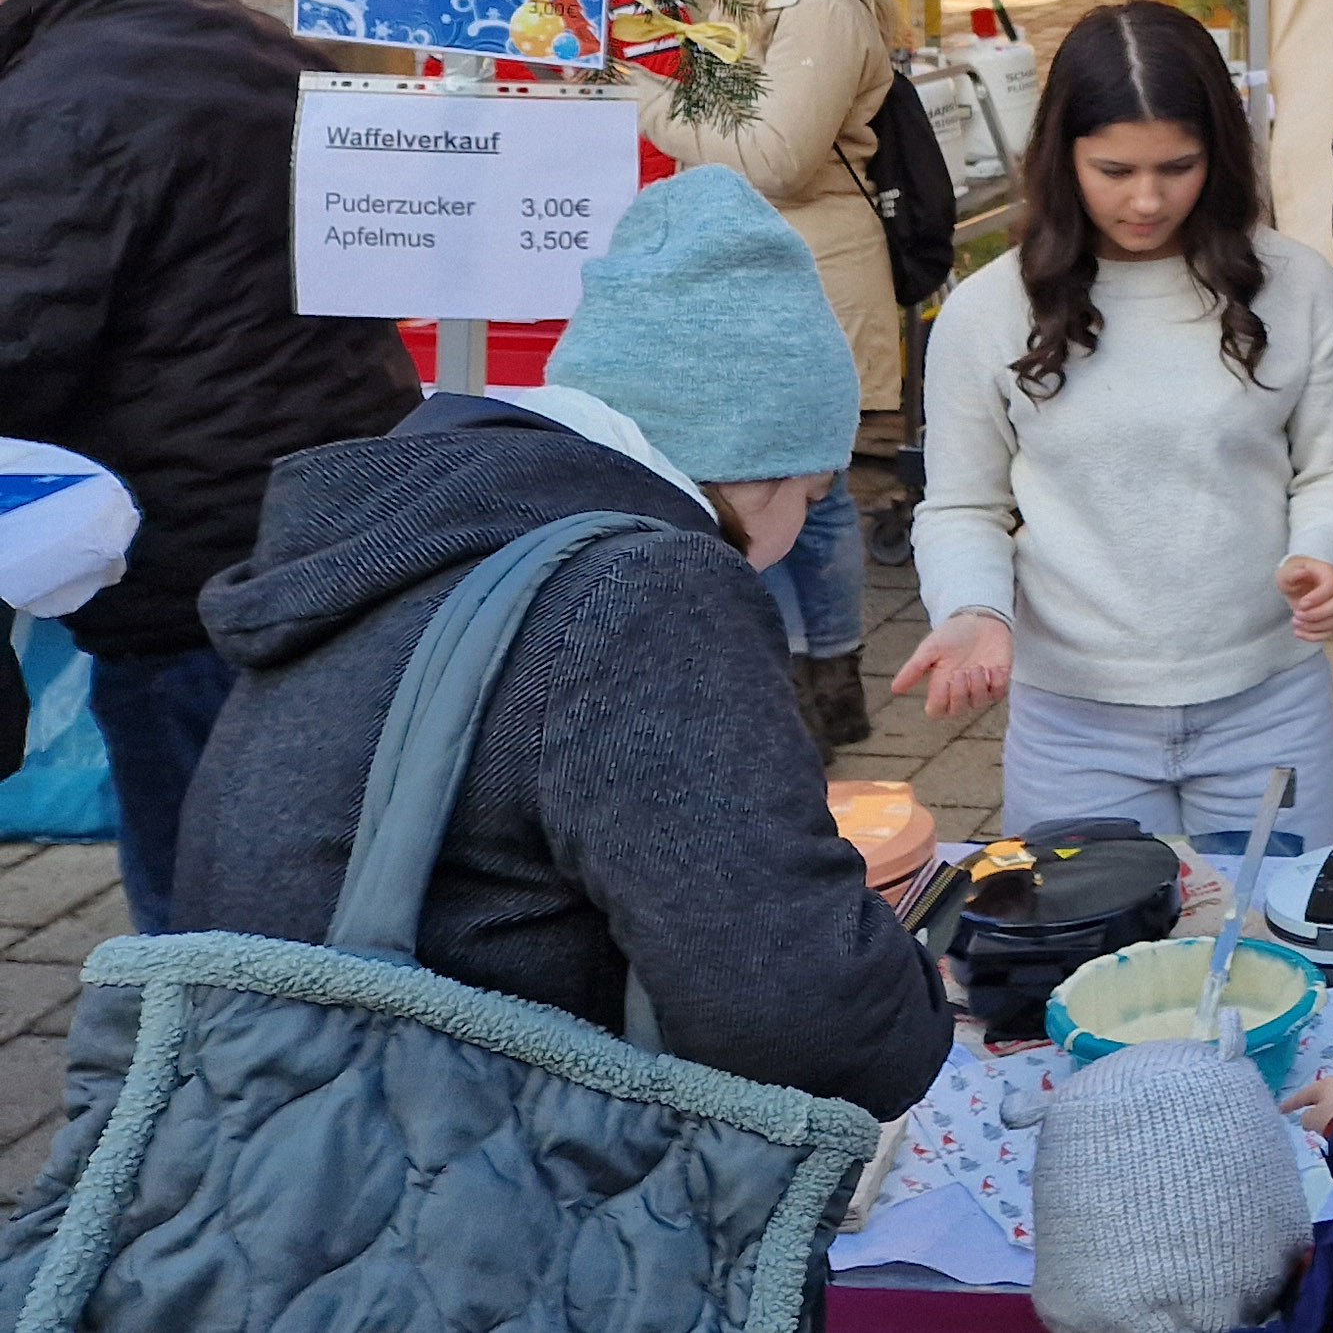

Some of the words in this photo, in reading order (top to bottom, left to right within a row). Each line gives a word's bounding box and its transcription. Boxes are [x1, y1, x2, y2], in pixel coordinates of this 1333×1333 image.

[326, 126, 501, 153] Waffelverkauf
[325, 192, 477, 216] Puderzucker
[521, 197, 591, 220] 3,00€
[324, 226, 436, 250] Apfelmus
[520, 230, 590, 254] 3,50€
